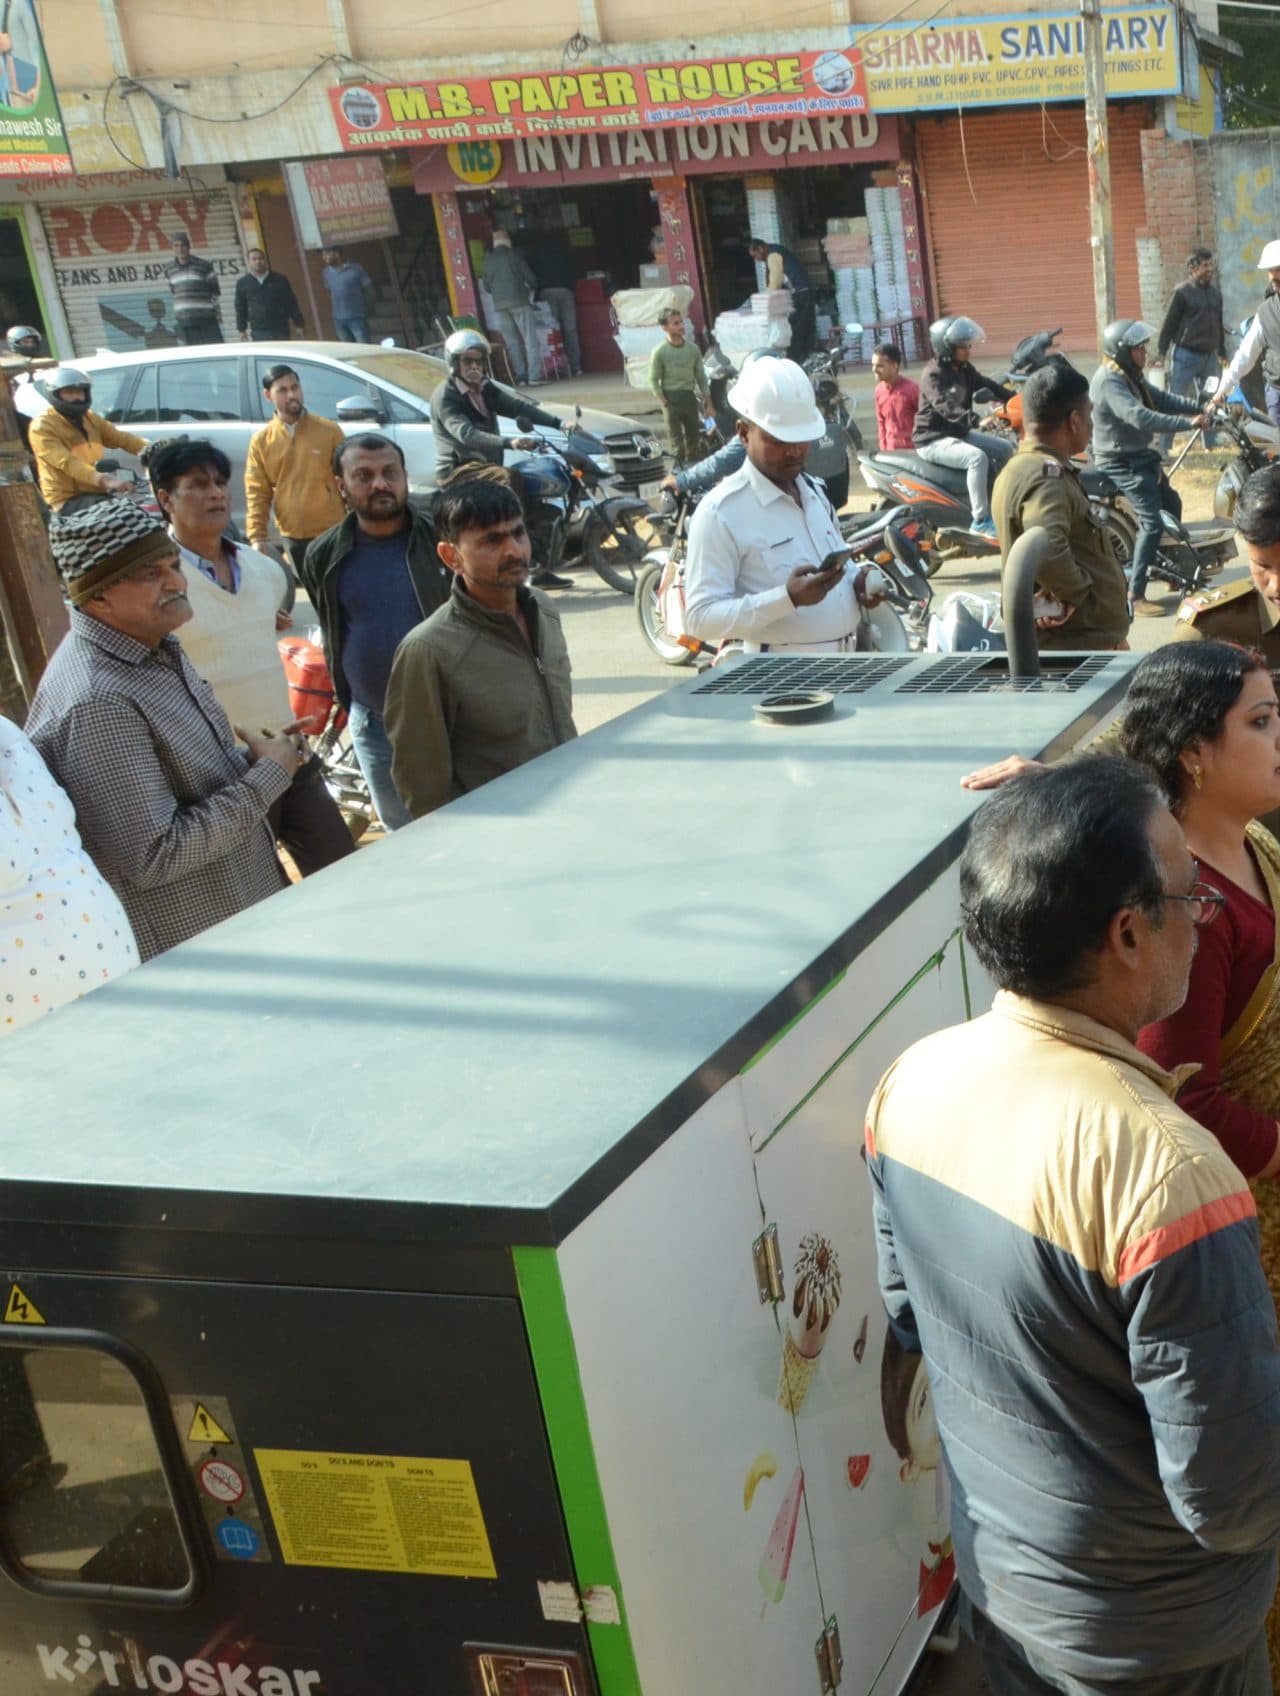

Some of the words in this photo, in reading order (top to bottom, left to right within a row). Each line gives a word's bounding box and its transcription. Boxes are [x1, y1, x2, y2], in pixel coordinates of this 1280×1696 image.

[864, 29, 988, 69] SHARMA
[1000, 14, 1168, 60] SANIARY
[384, 82, 485, 122] M.B.
[489, 70, 638, 115] PAPER
[644, 56, 806, 104] HOUSE
[917, 73, 942, 88] HAND
[1103, 59, 1142, 74] TTINGS
[44, 117, 63, 137] Sir
[427, 121, 471, 141] शादी
[458, 139, 495, 175] MB
[759, 112, 879, 156] CARD
[50, 199, 210, 258] ROXY
[60, 267, 101, 286] FANS
[107, 264, 137, 283] AND
